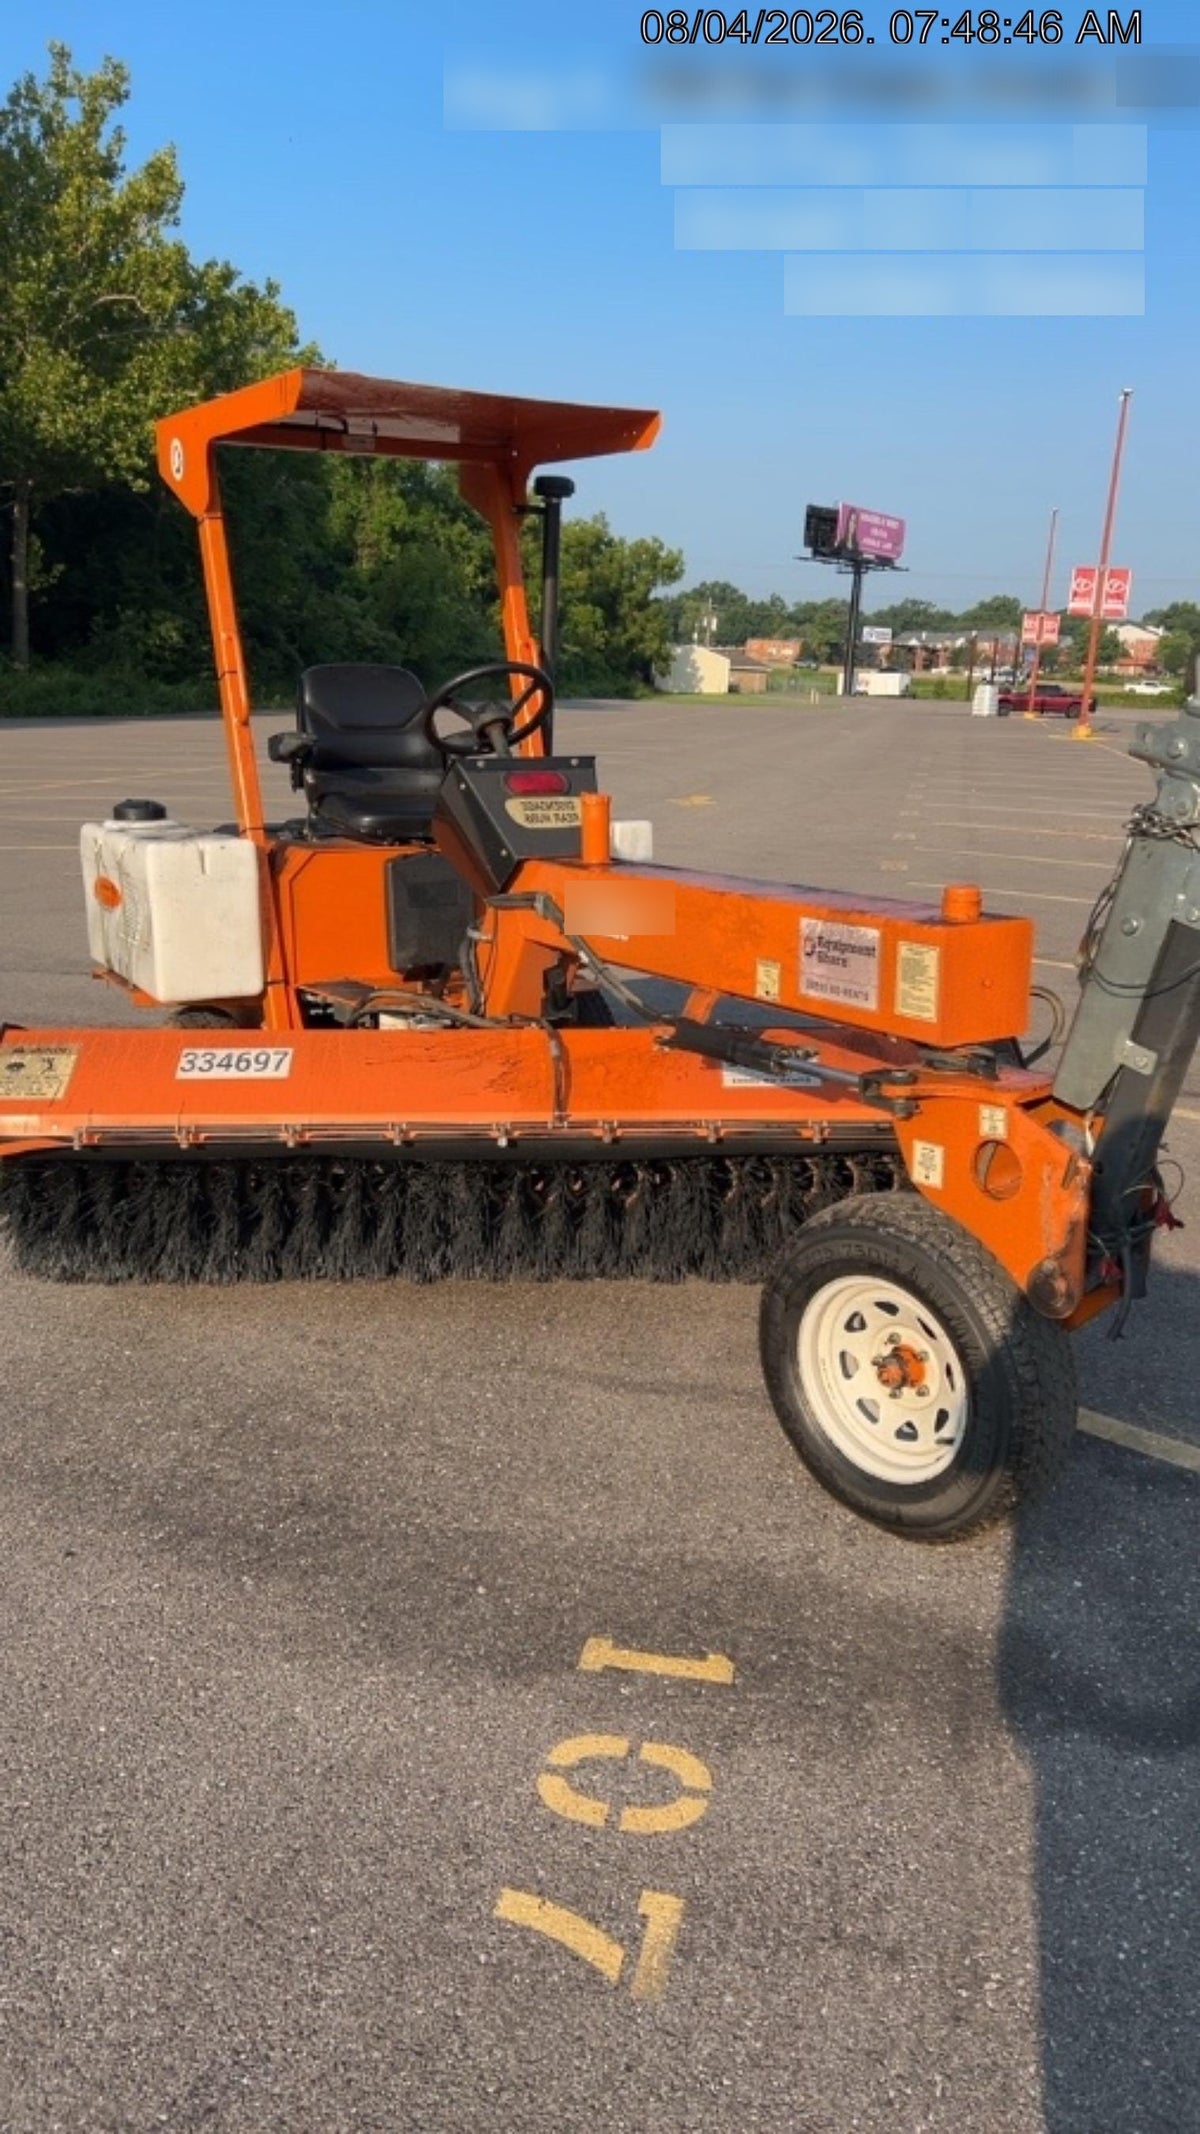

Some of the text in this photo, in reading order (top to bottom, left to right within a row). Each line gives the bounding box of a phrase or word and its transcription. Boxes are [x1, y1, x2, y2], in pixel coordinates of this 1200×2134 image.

[817, 935, 876, 958] Equipment
[817, 950, 848, 968] Share
[180, 1051, 289, 1073] 334697
[494, 1636, 736, 2000] 107
